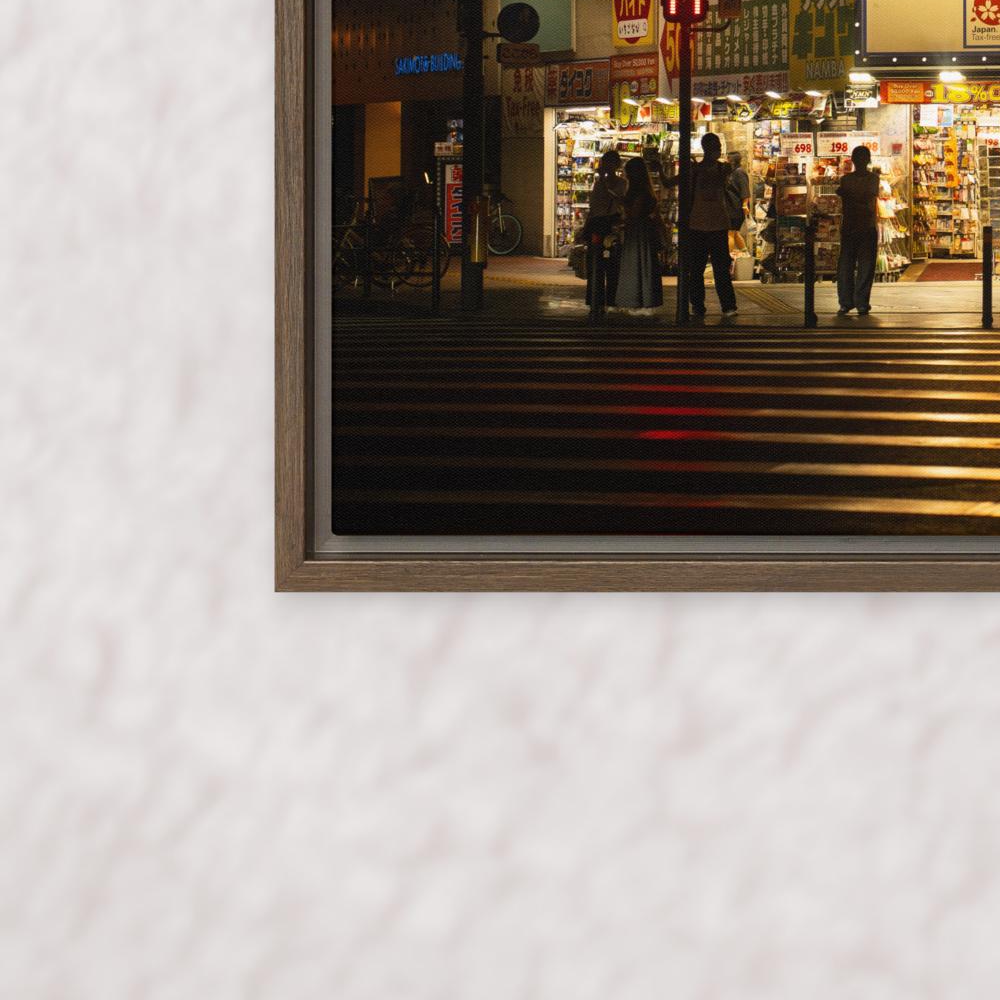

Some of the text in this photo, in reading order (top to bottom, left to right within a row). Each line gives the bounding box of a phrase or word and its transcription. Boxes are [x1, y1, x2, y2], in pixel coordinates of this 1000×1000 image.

[805, 59, 845, 81] NAMBA
[794, 143, 812, 154] 698
[831, 142, 848, 153] 198
